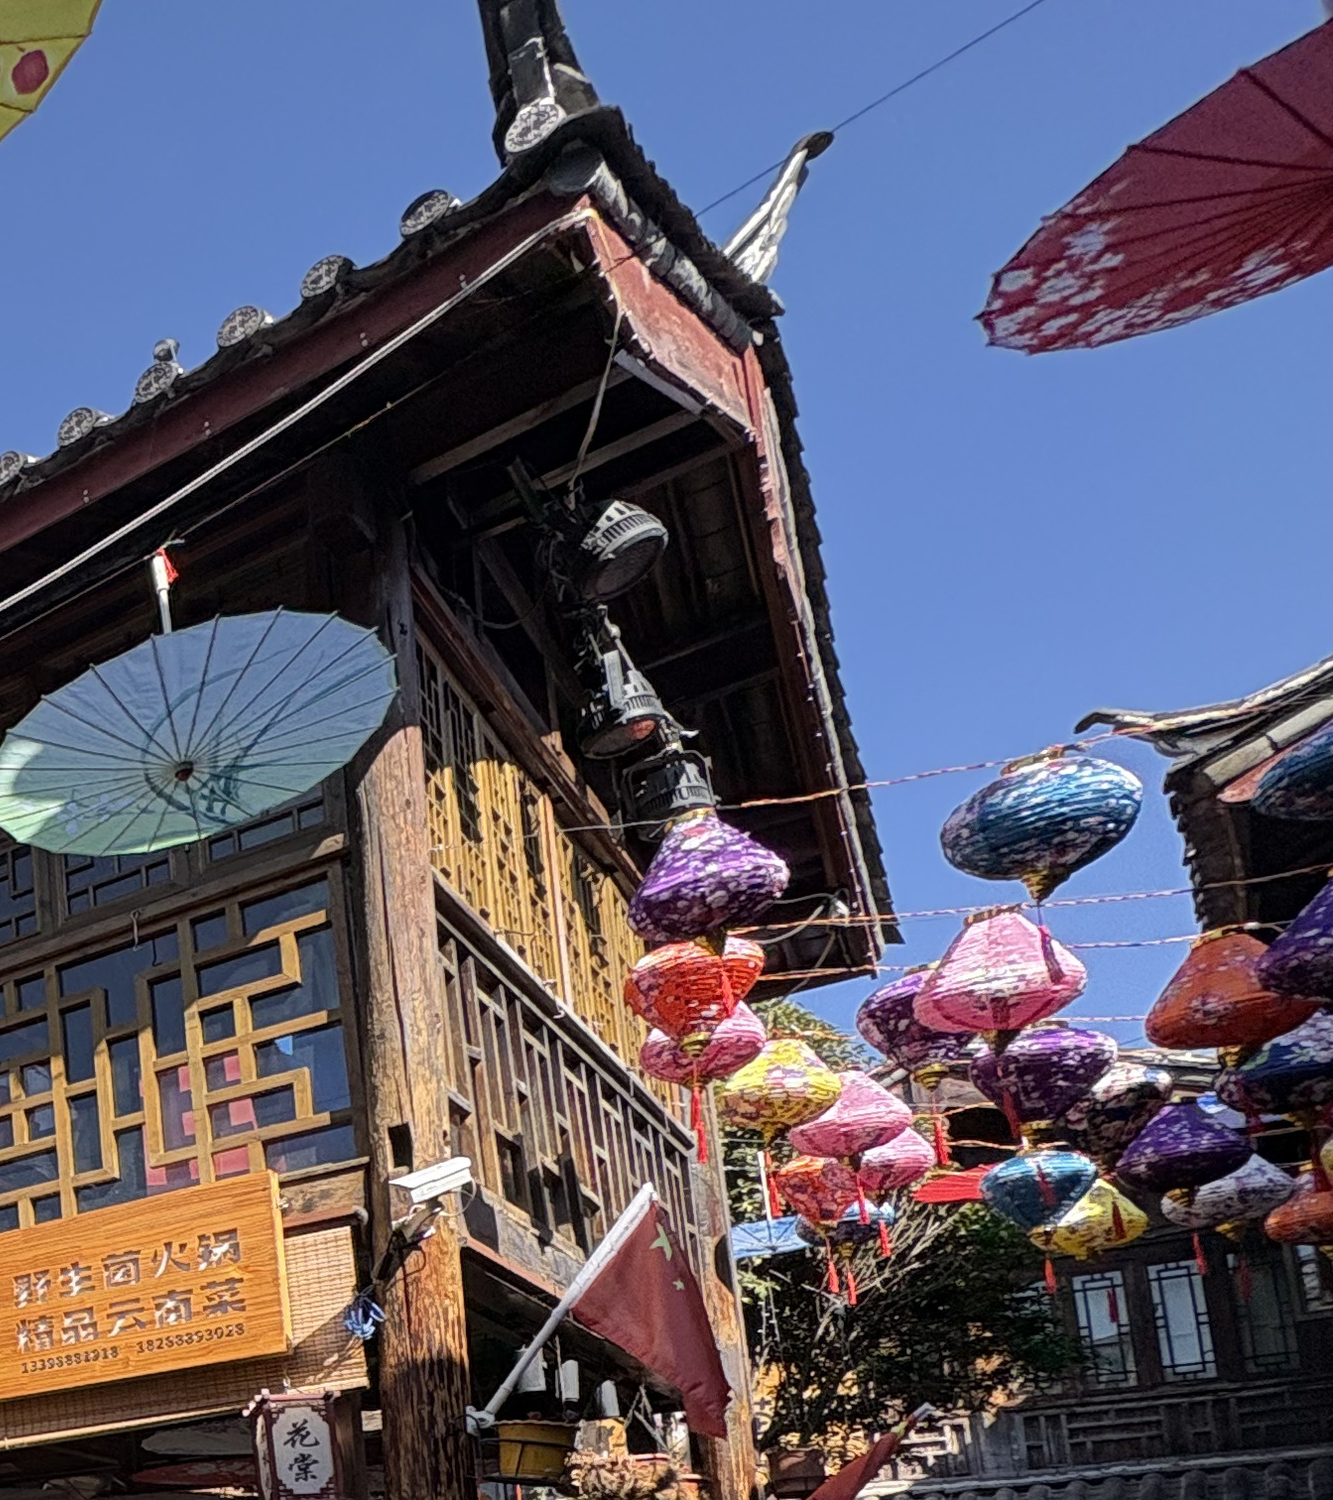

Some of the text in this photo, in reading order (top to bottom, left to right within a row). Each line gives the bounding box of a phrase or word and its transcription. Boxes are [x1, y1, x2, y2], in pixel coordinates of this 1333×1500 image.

[13, 1228, 241, 1309] 野生菌火锅
[15, 1278, 247, 1354] 精品云南菜
